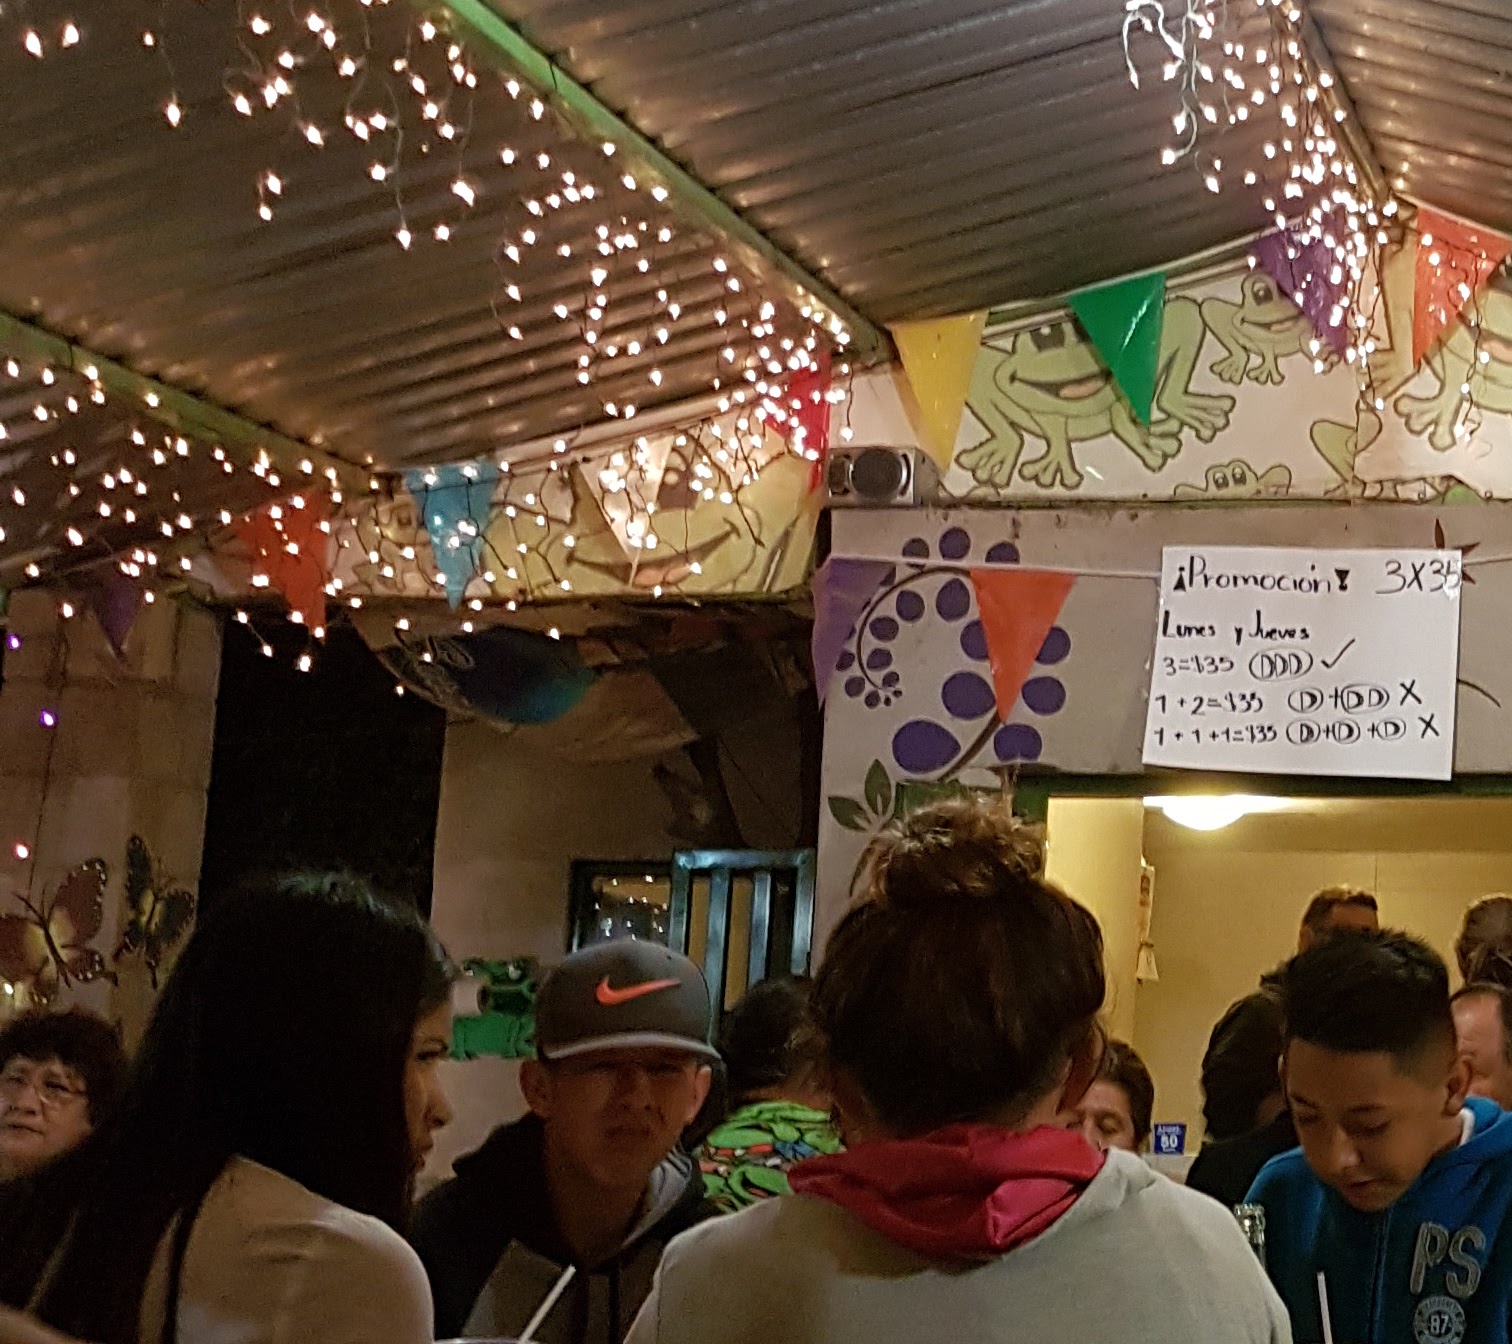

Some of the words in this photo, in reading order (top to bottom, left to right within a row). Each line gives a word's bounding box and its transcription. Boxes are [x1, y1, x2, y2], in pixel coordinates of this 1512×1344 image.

[1162, 608, 1216, 639] Lunes
[1233, 625, 1244, 647] y
[1249, 608, 1310, 640] Jueves
[1410, 1221, 1487, 1298] PS
[1429, 1314, 1450, 1335] 87
